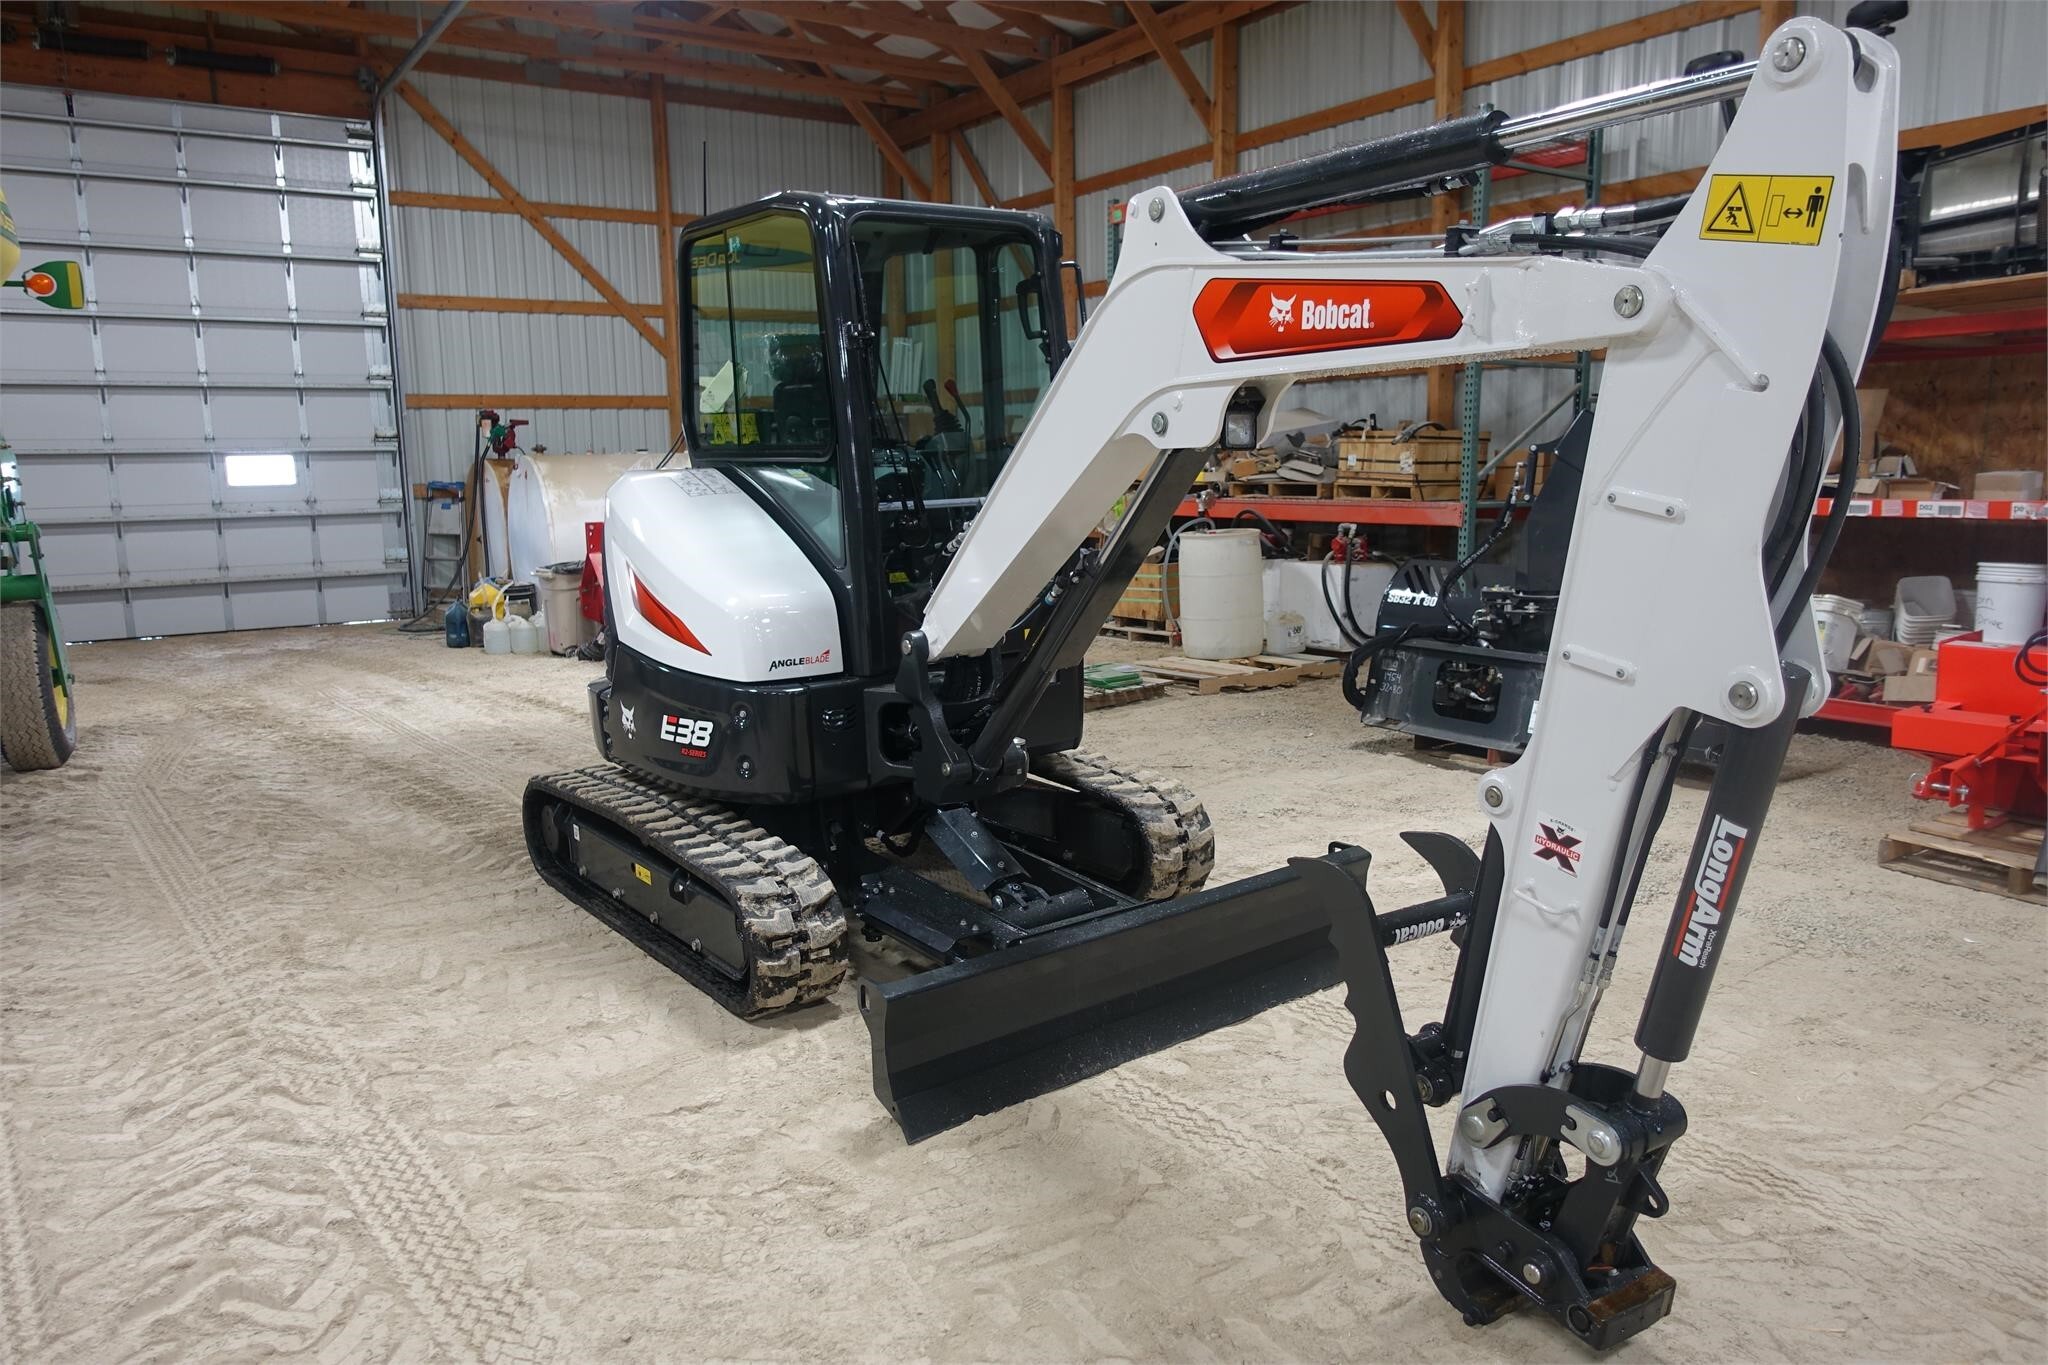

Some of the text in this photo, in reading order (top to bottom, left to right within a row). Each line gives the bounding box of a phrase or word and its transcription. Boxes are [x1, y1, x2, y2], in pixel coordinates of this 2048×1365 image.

[1301, 298, 1371, 330] Bobcat
[769, 651, 830, 672] ANGLEBLADE
[661, 714, 714, 747] E38
[1535, 836, 1580, 860] HYDRAULIC
[1678, 814, 1748, 967] LongArm
[1699, 929, 1718, 969] XtraReach
